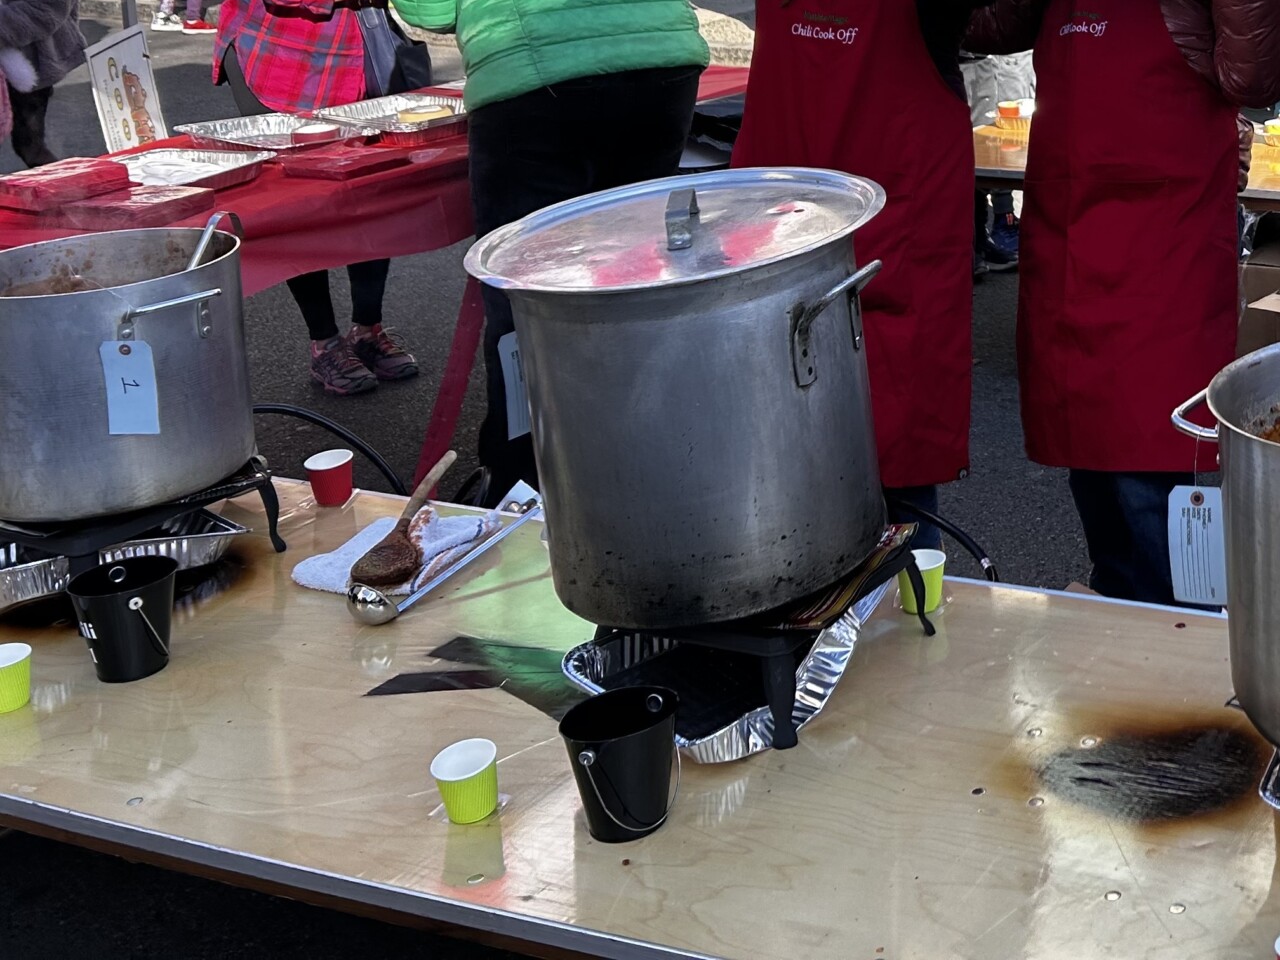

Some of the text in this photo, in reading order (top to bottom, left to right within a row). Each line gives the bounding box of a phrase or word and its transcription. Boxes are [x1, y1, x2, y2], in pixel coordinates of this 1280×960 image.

[791, 23, 859, 44] Chili Cook Off
[1090, 20, 1108, 37] Off
